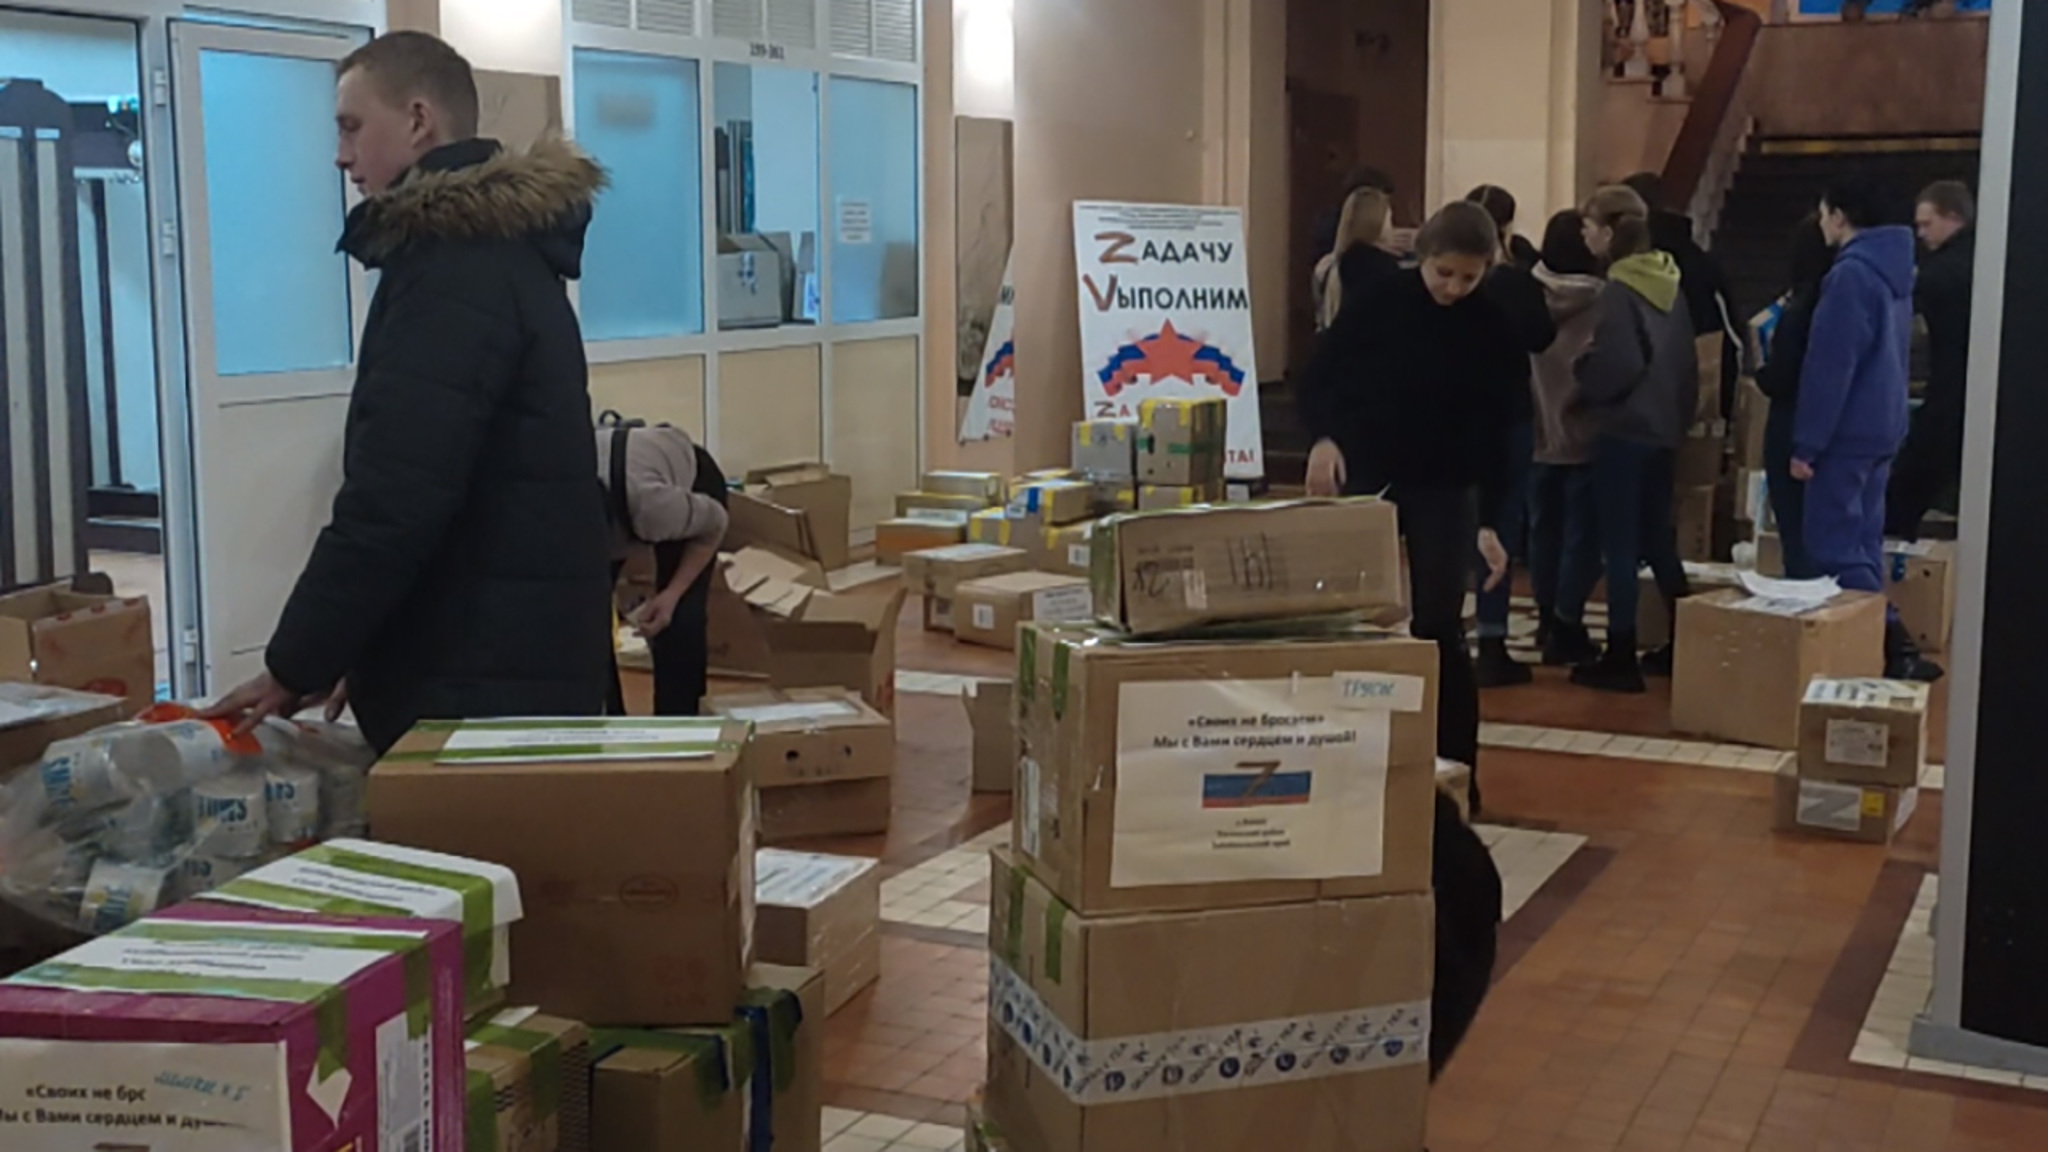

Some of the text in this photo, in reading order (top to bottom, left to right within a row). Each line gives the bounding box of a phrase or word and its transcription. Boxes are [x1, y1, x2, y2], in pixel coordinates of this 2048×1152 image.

[1094, 231, 1233, 264] ZАДАЧУ
[1082, 273, 1248, 312] VЫПОЛНИМ
[1153, 736, 1178, 748] Мы
[1193, 735, 1230, 748] Вами
[1233, 734, 1293, 751] сердцем
[26, 1084, 88, 1098] «Своих
[92, 1087, 112, 1100] не
[22, 1110, 32, 1122] с
[35, 1109, 81, 1124] Вами
[86, 1112, 162, 1128] сердцем
[166, 1114, 177, 1126] и
